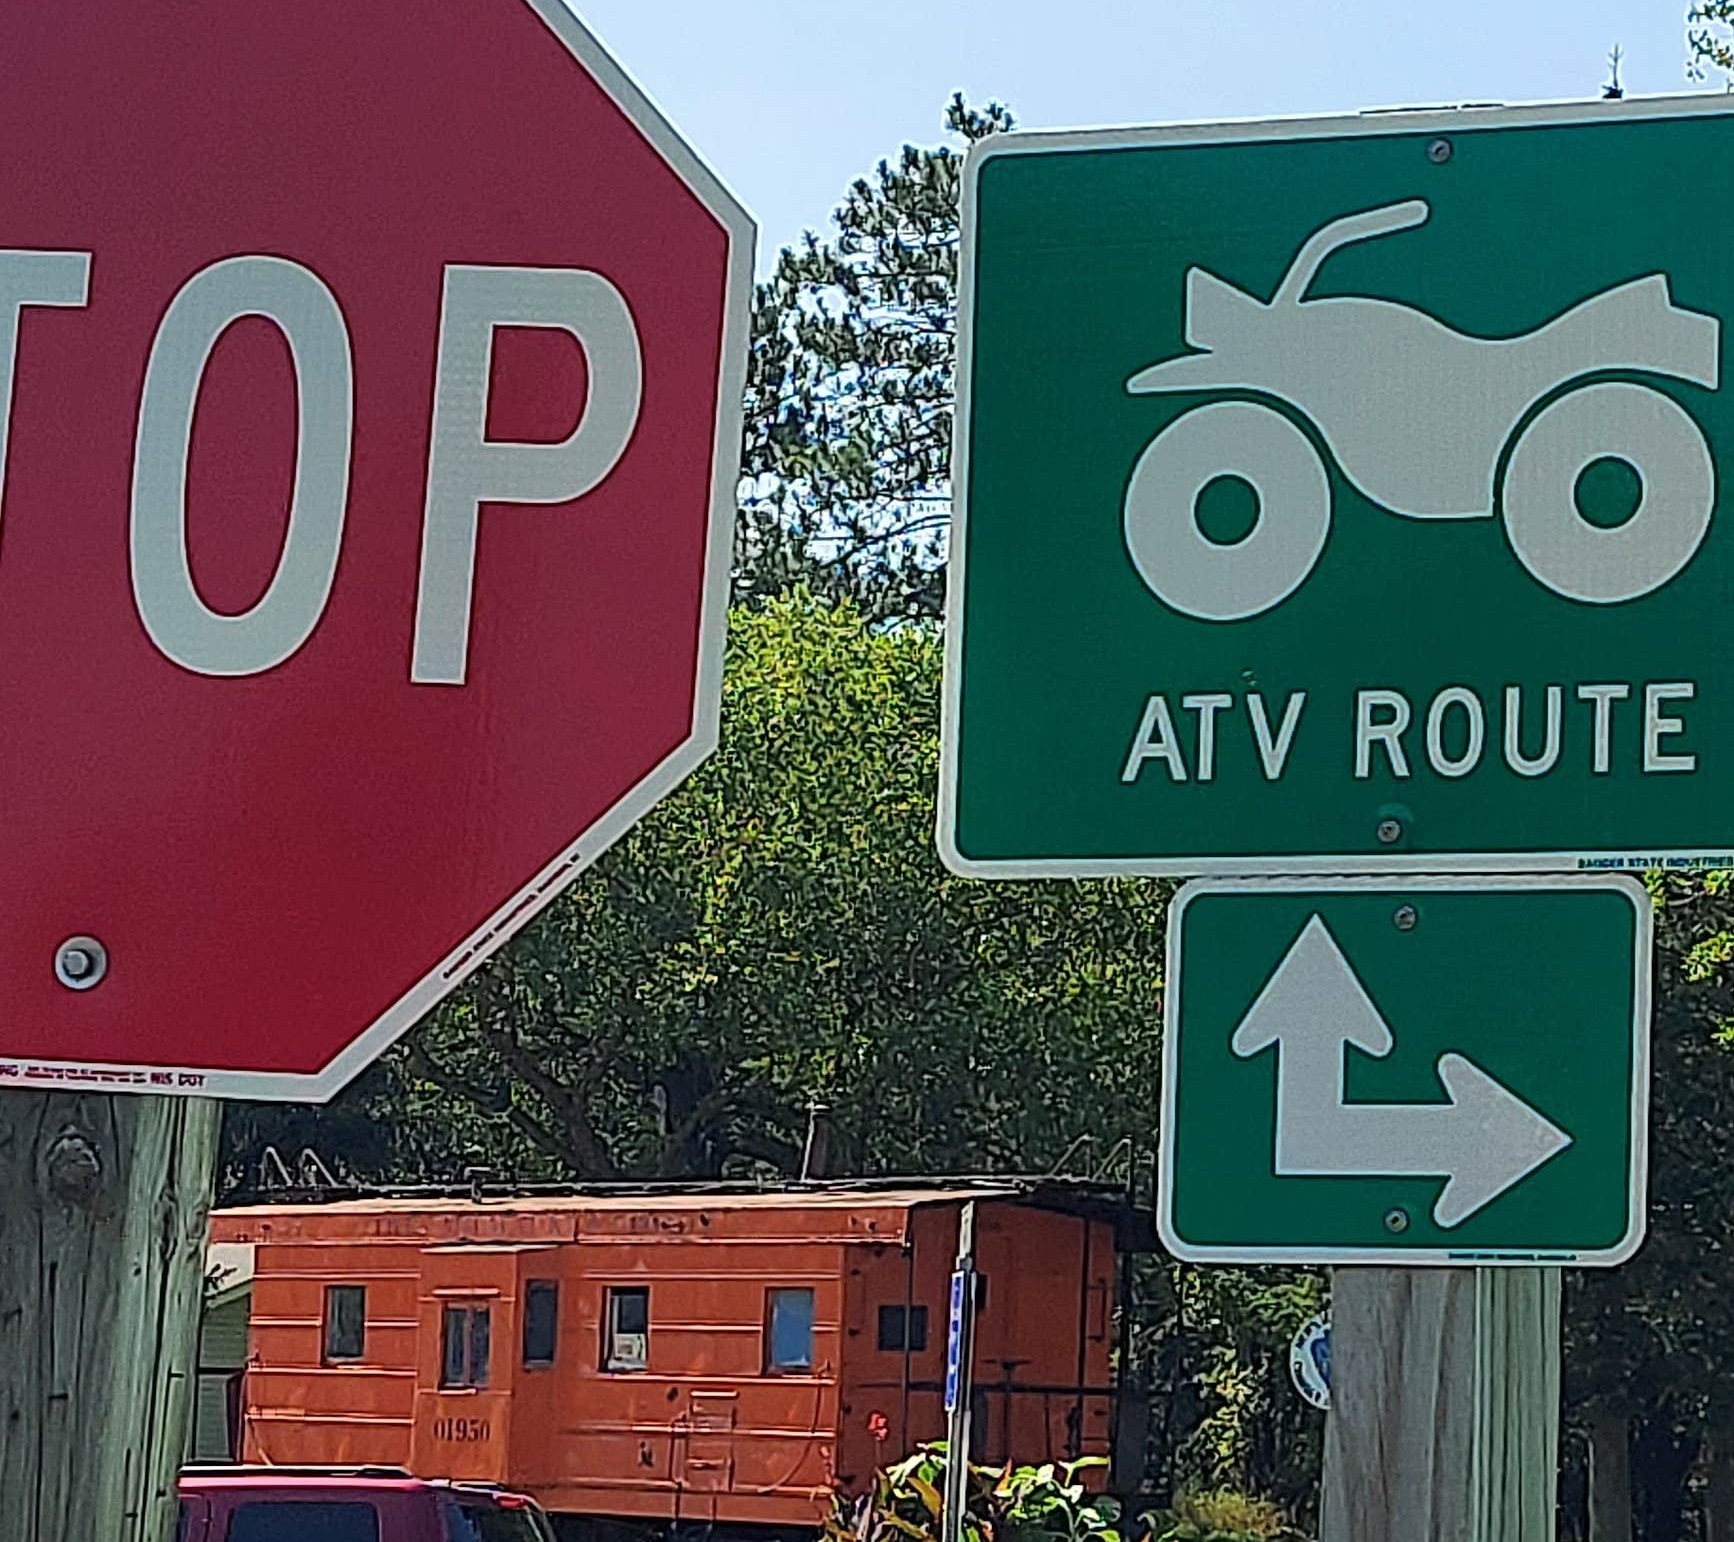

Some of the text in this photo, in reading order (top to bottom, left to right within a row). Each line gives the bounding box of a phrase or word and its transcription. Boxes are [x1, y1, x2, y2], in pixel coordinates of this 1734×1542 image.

[1121, 682, 1696, 782] ATV ROUTE
[433, 1418, 490, 1442] 01950
